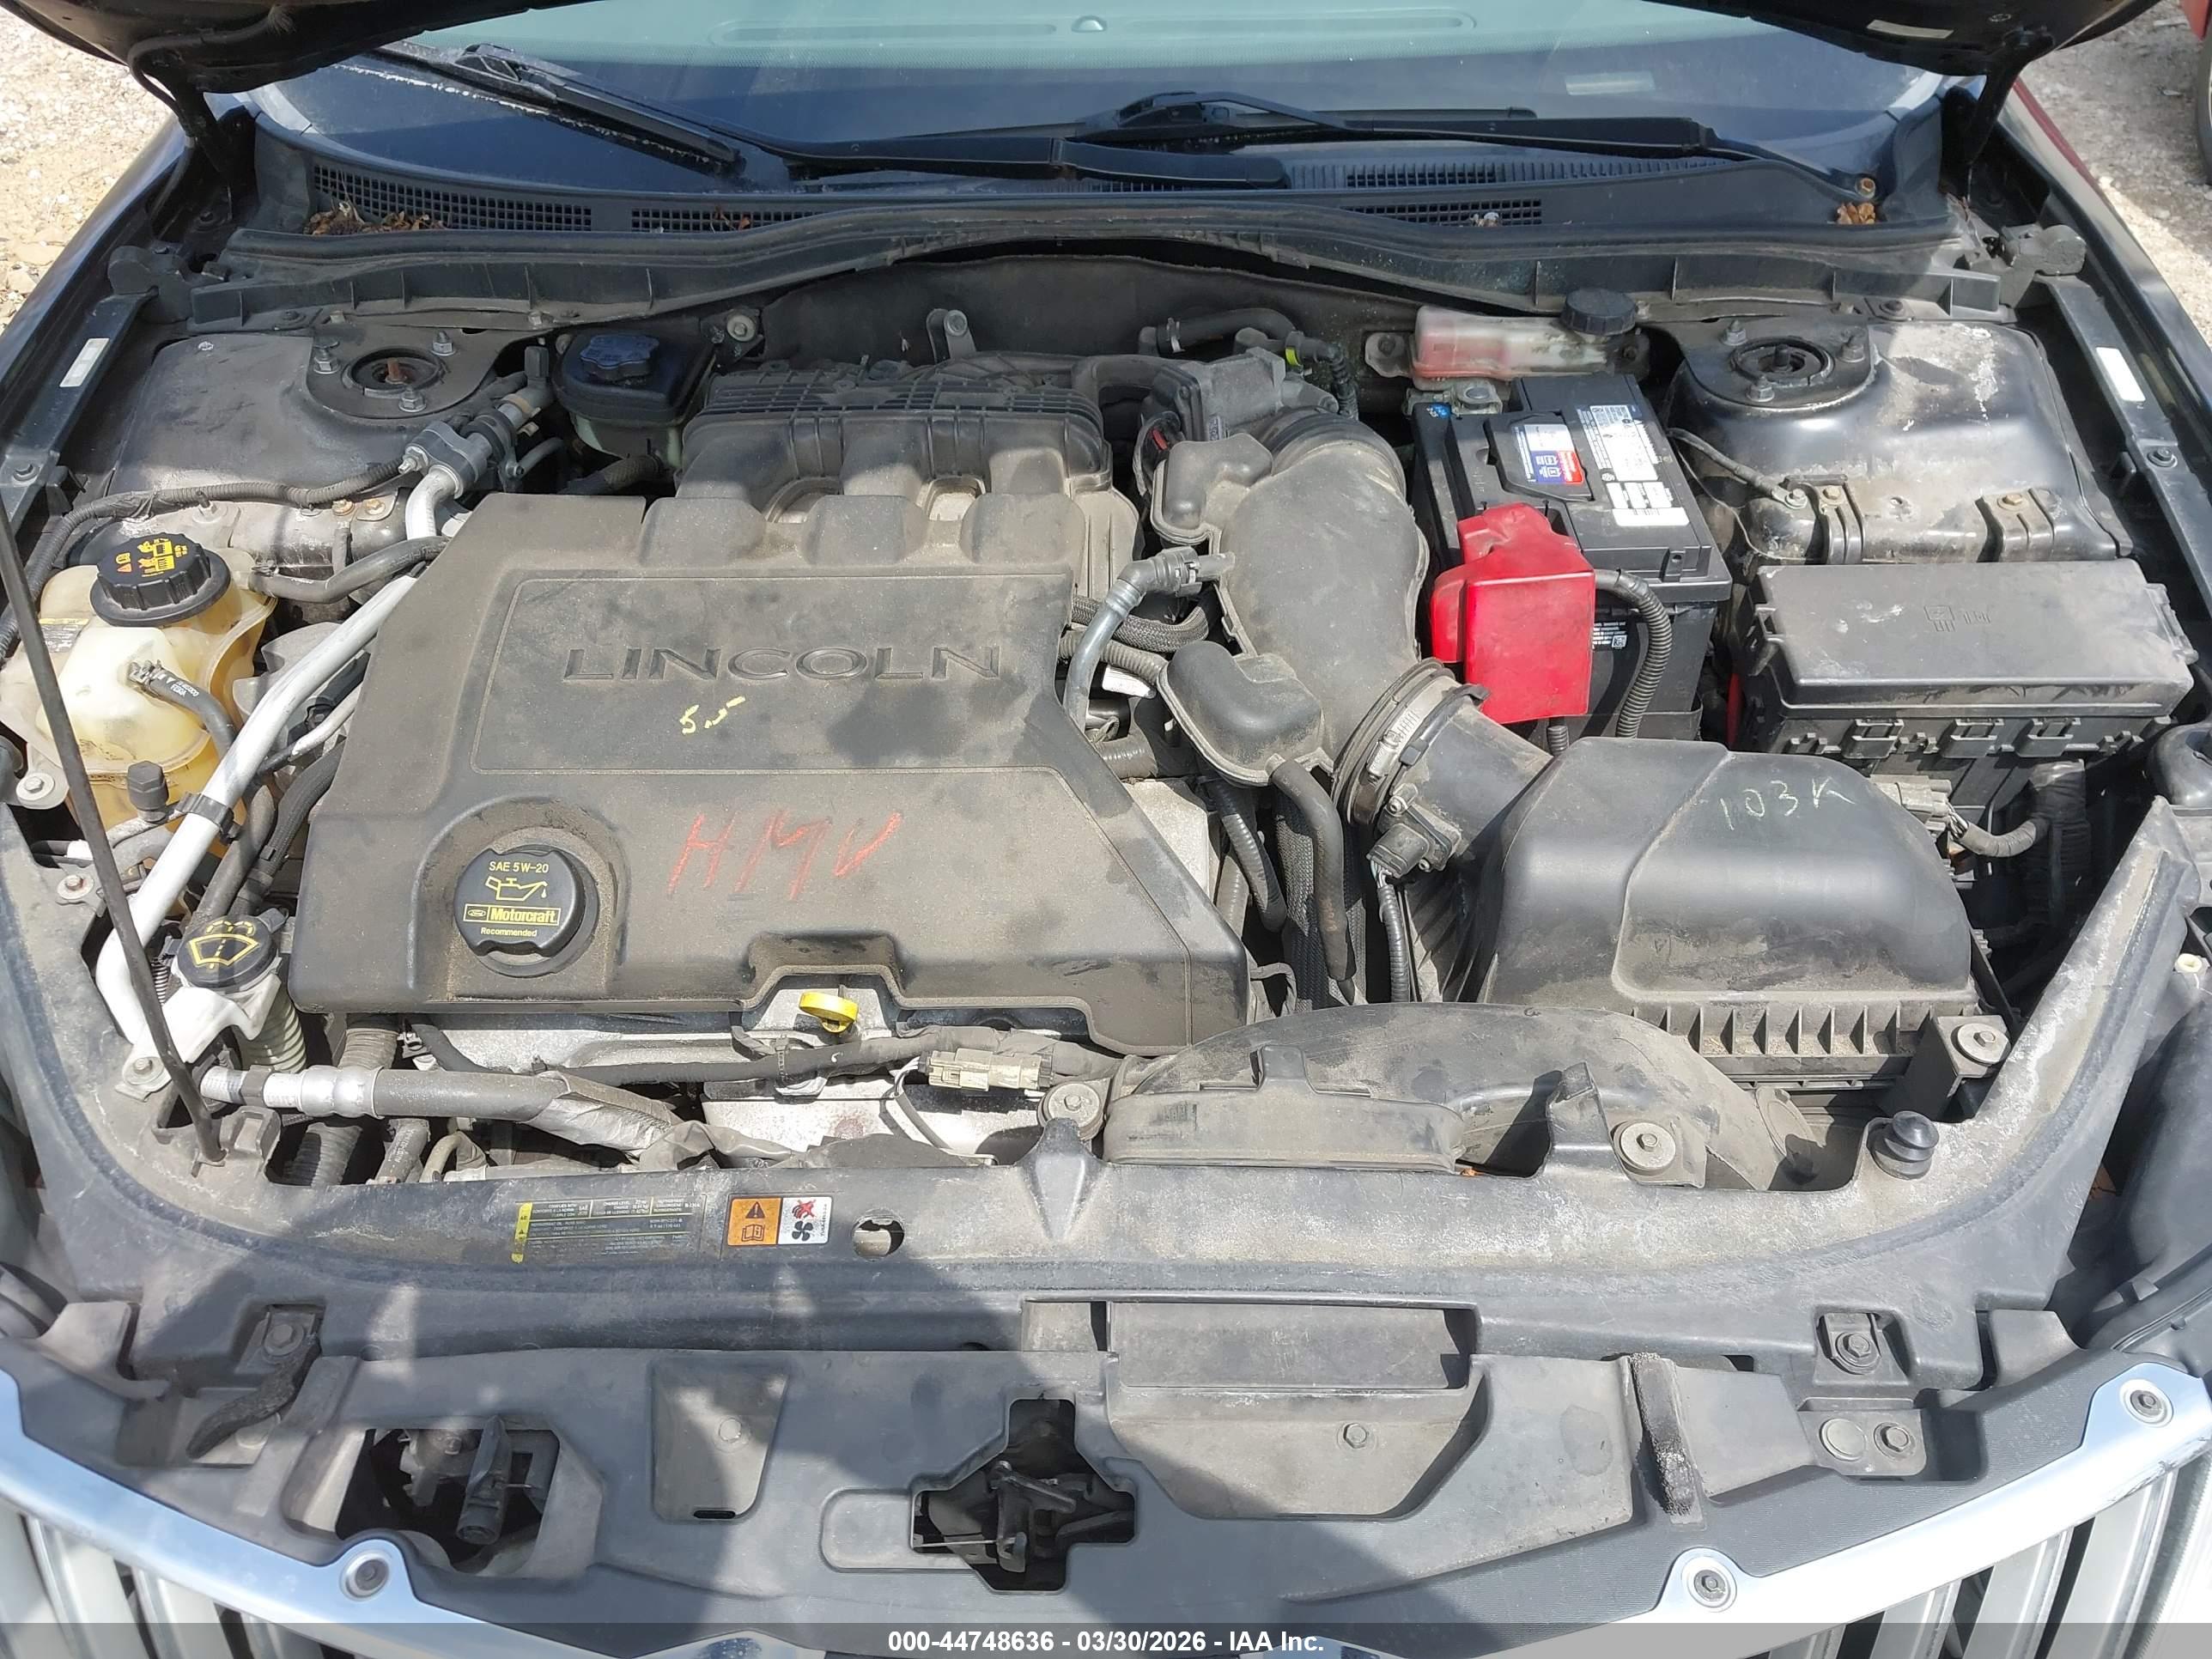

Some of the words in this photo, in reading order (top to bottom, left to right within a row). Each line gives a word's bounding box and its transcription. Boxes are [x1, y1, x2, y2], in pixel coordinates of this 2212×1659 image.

[562, 647, 1001, 682] LINCOLN
[489, 861, 511, 872] SAE
[513, 862, 550, 873] 5W-20
[490, 908, 556, 923] Motorcraft
[480, 927, 538, 937] Recommended
